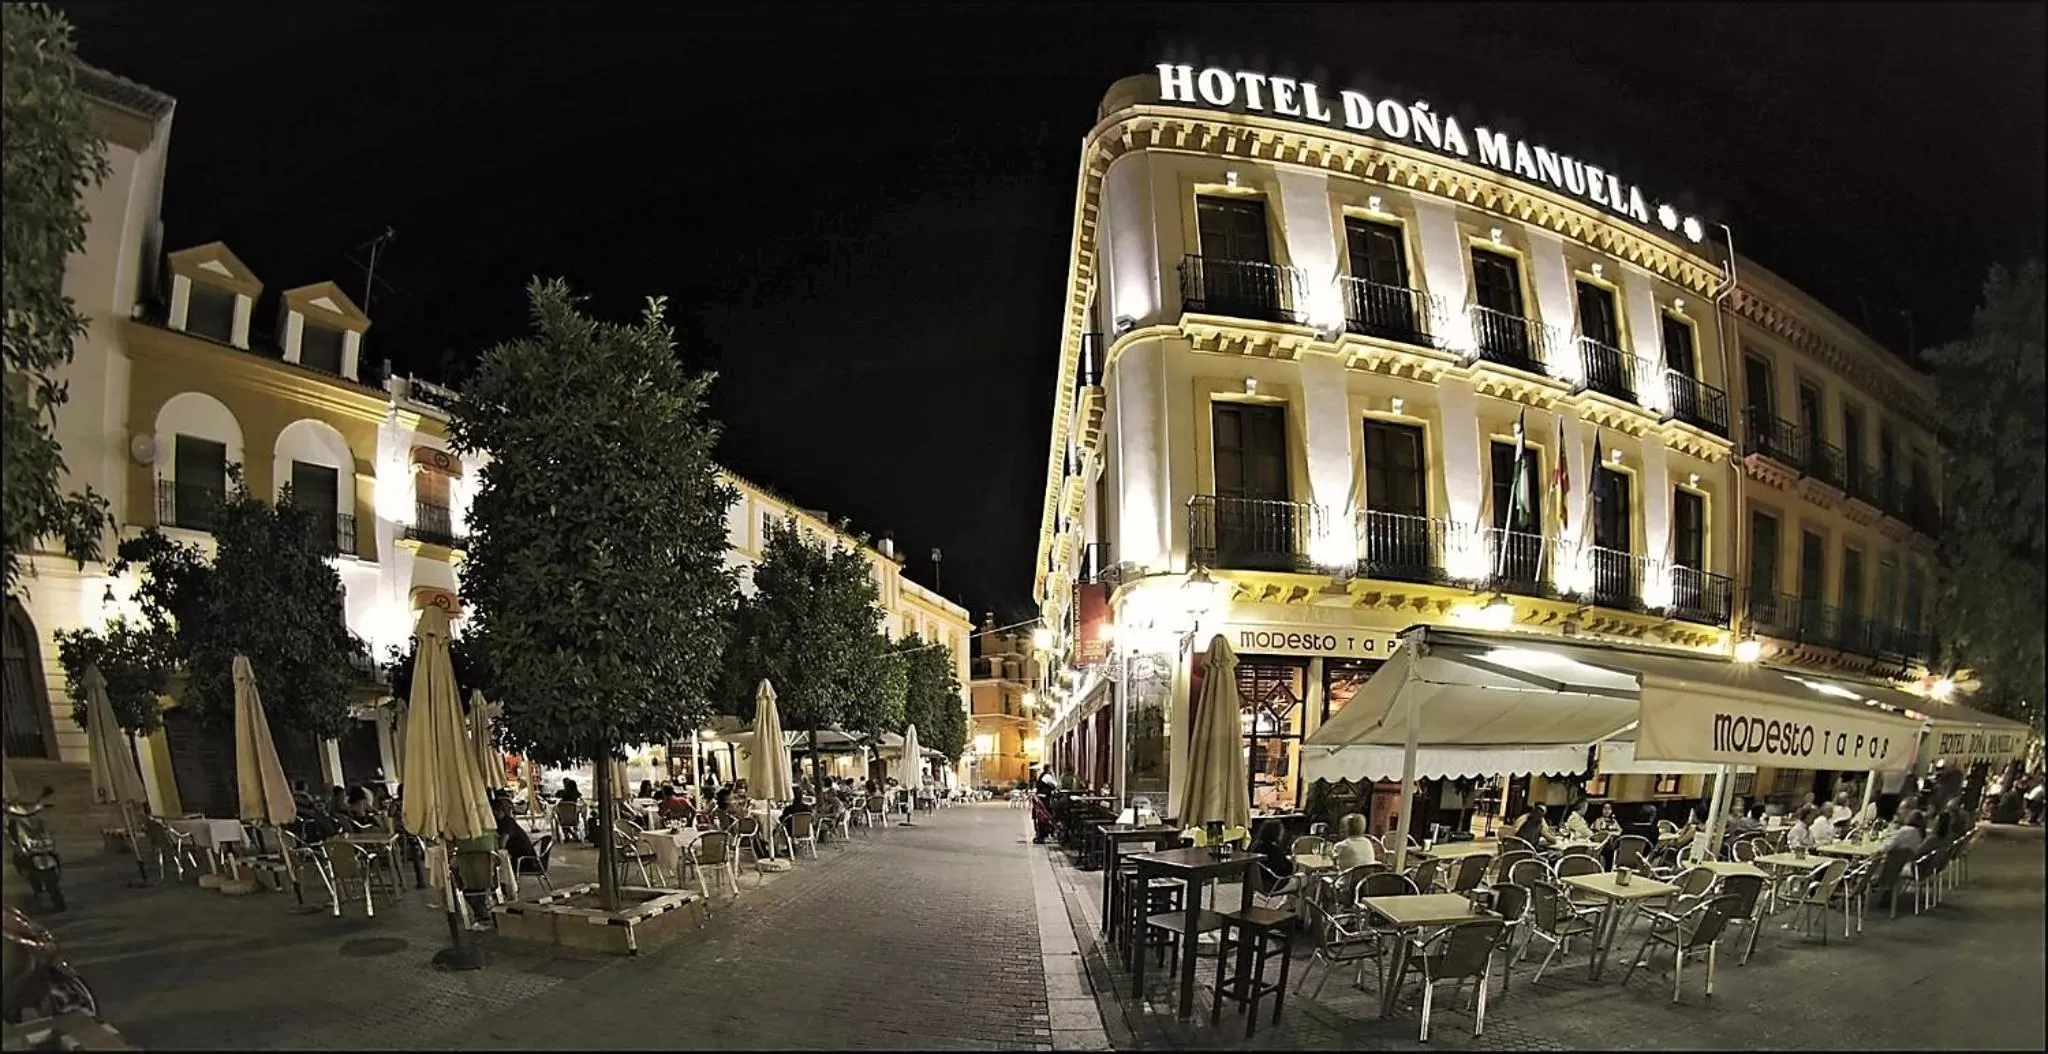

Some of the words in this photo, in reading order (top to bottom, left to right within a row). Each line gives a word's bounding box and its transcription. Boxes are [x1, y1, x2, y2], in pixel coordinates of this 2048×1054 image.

[1156, 63, 1331, 123] HOTEL
[1341, 90, 1468, 156] DOÑA
[1474, 127, 1649, 224] MANUELA
